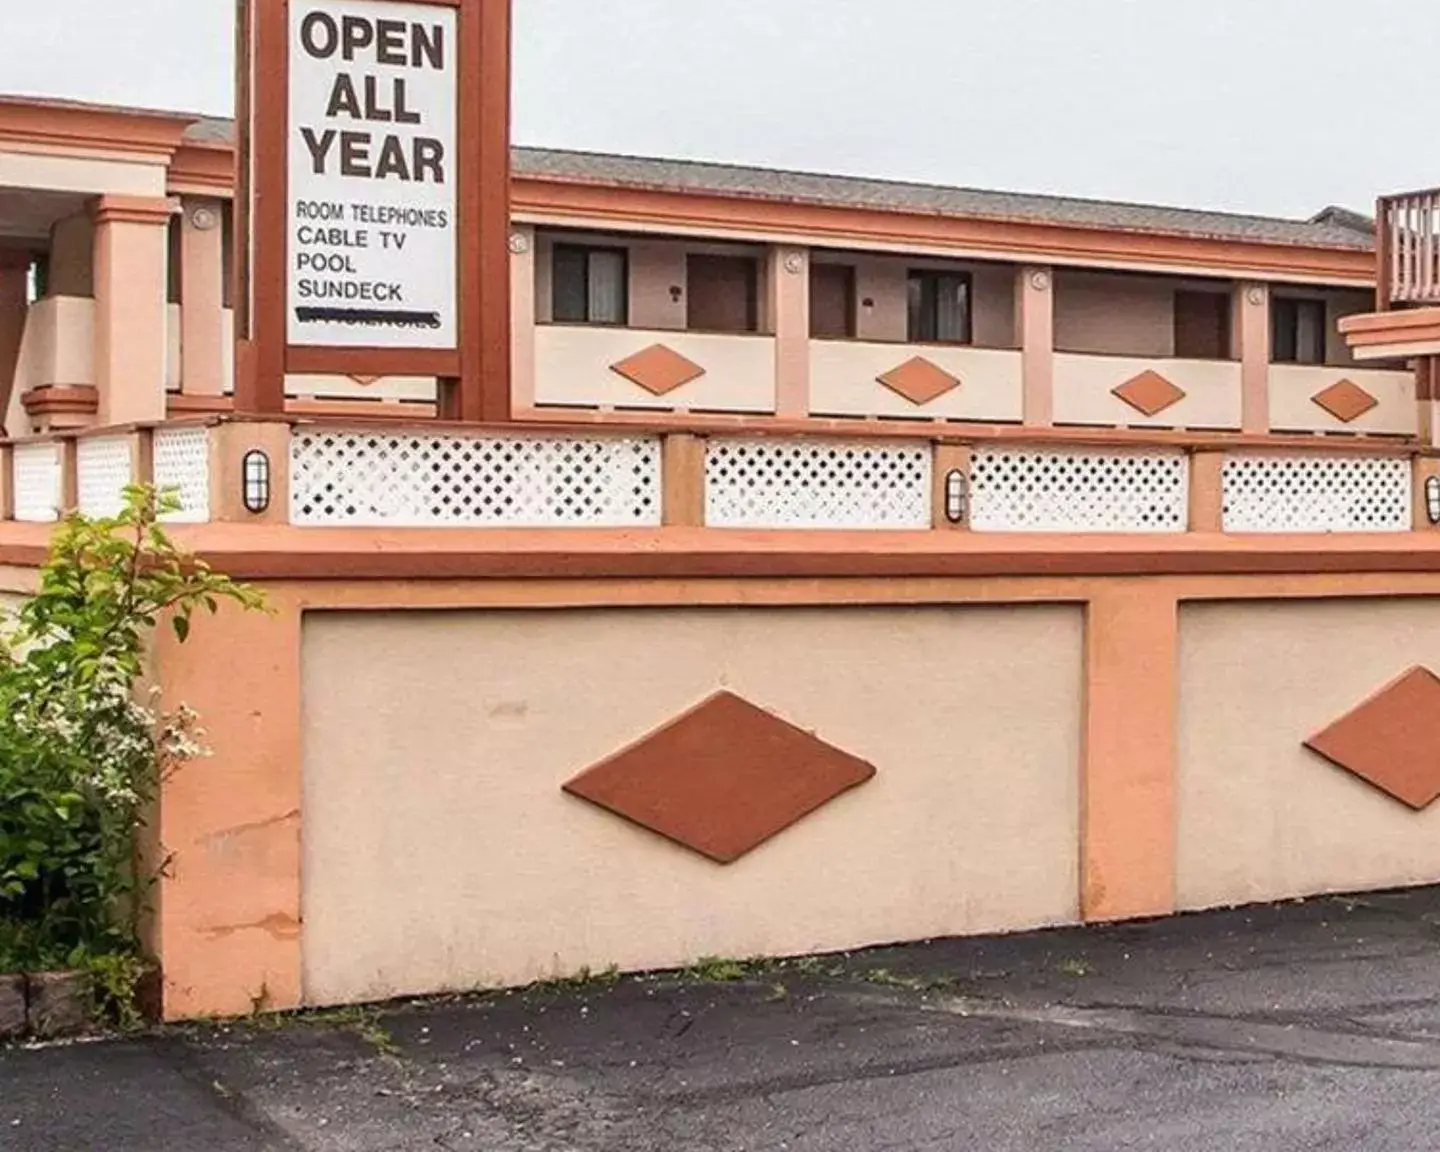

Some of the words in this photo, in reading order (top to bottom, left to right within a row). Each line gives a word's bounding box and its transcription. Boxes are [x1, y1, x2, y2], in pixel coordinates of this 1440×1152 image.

[300, 10, 445, 71] OPEN
[325, 72, 422, 125] ALL
[299, 127, 446, 185] YEAR
[296, 199, 345, 221] ROOM
[351, 203, 448, 229] TELEPHONES
[297, 225, 368, 249] CABLE
[379, 231, 407, 251] TV
[297, 251, 357, 274] POOL
[298, 279, 403, 303] SUNDECK
